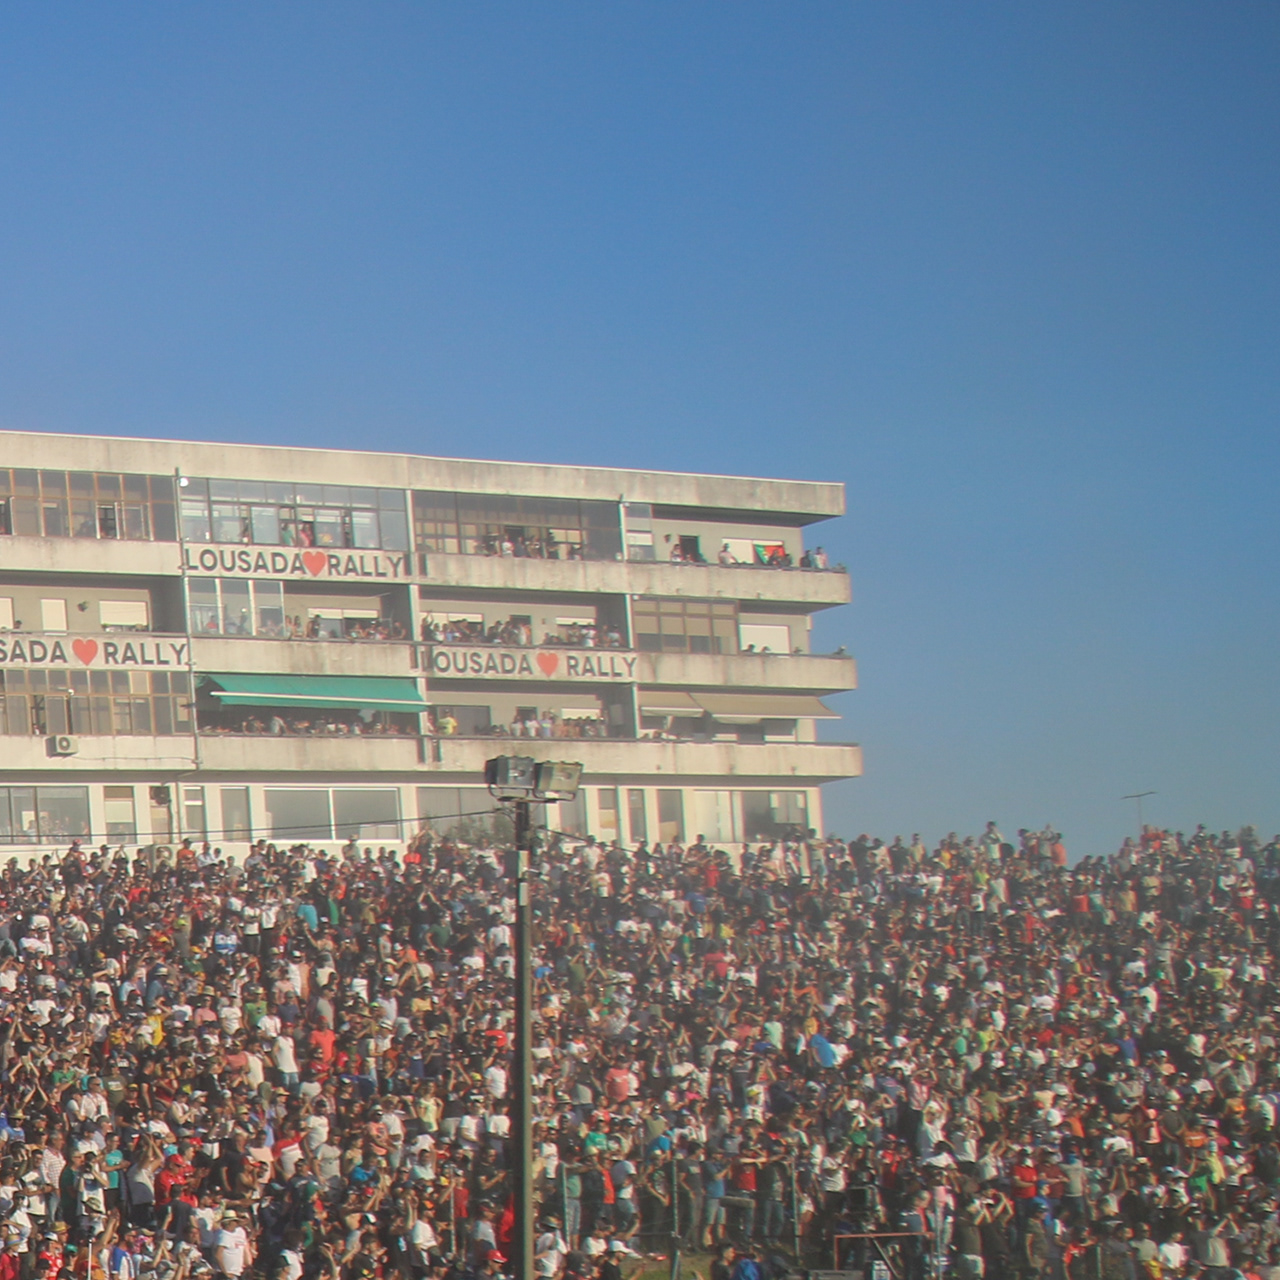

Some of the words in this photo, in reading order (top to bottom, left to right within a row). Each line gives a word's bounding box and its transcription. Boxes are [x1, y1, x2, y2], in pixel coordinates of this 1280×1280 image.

[185, 548, 306, 575] LOUSADA
[327, 554, 403, 578] RALLY
[103, 641, 186, 666] RALLY
[566, 654, 637, 678] RALLY
